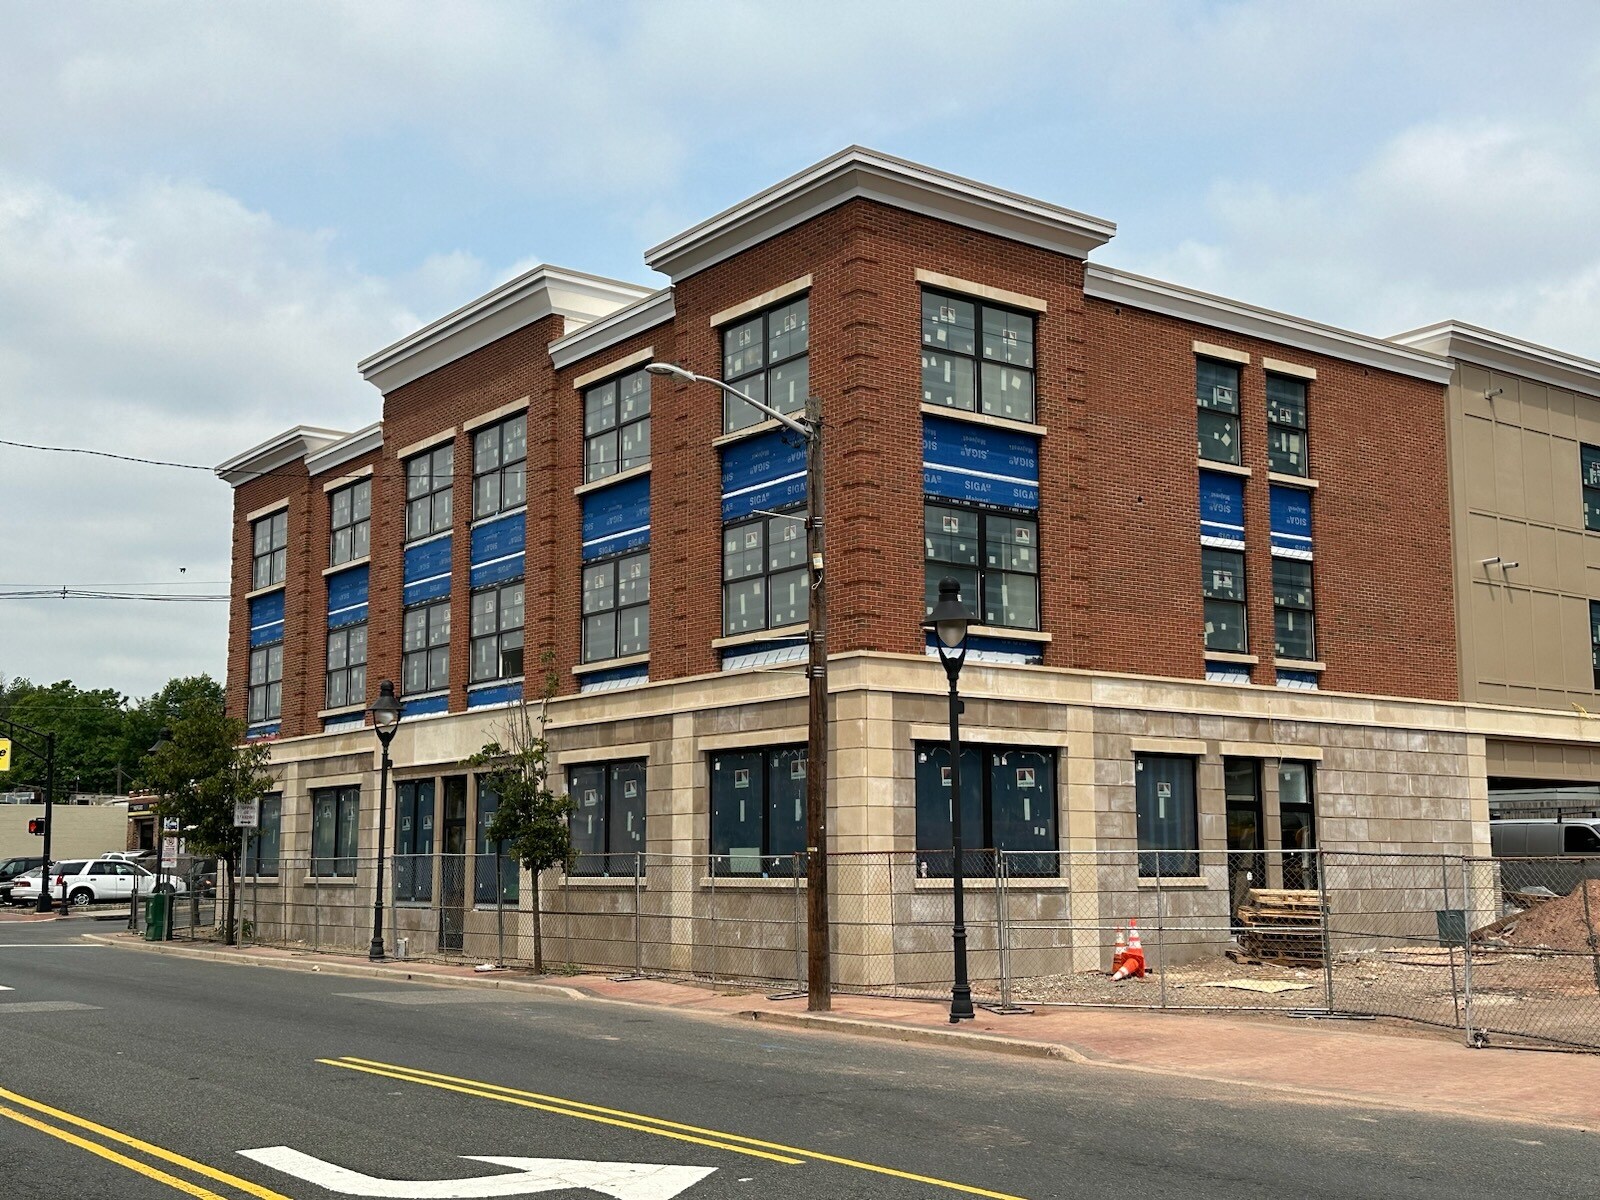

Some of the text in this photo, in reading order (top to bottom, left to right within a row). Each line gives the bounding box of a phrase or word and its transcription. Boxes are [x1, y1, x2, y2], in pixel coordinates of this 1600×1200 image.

[749, 493, 770, 506] SIGA
[787, 483, 807, 495] SIGA
[964, 480, 991, 492] SIGA
[1013, 488, 1038, 500] SIGA
